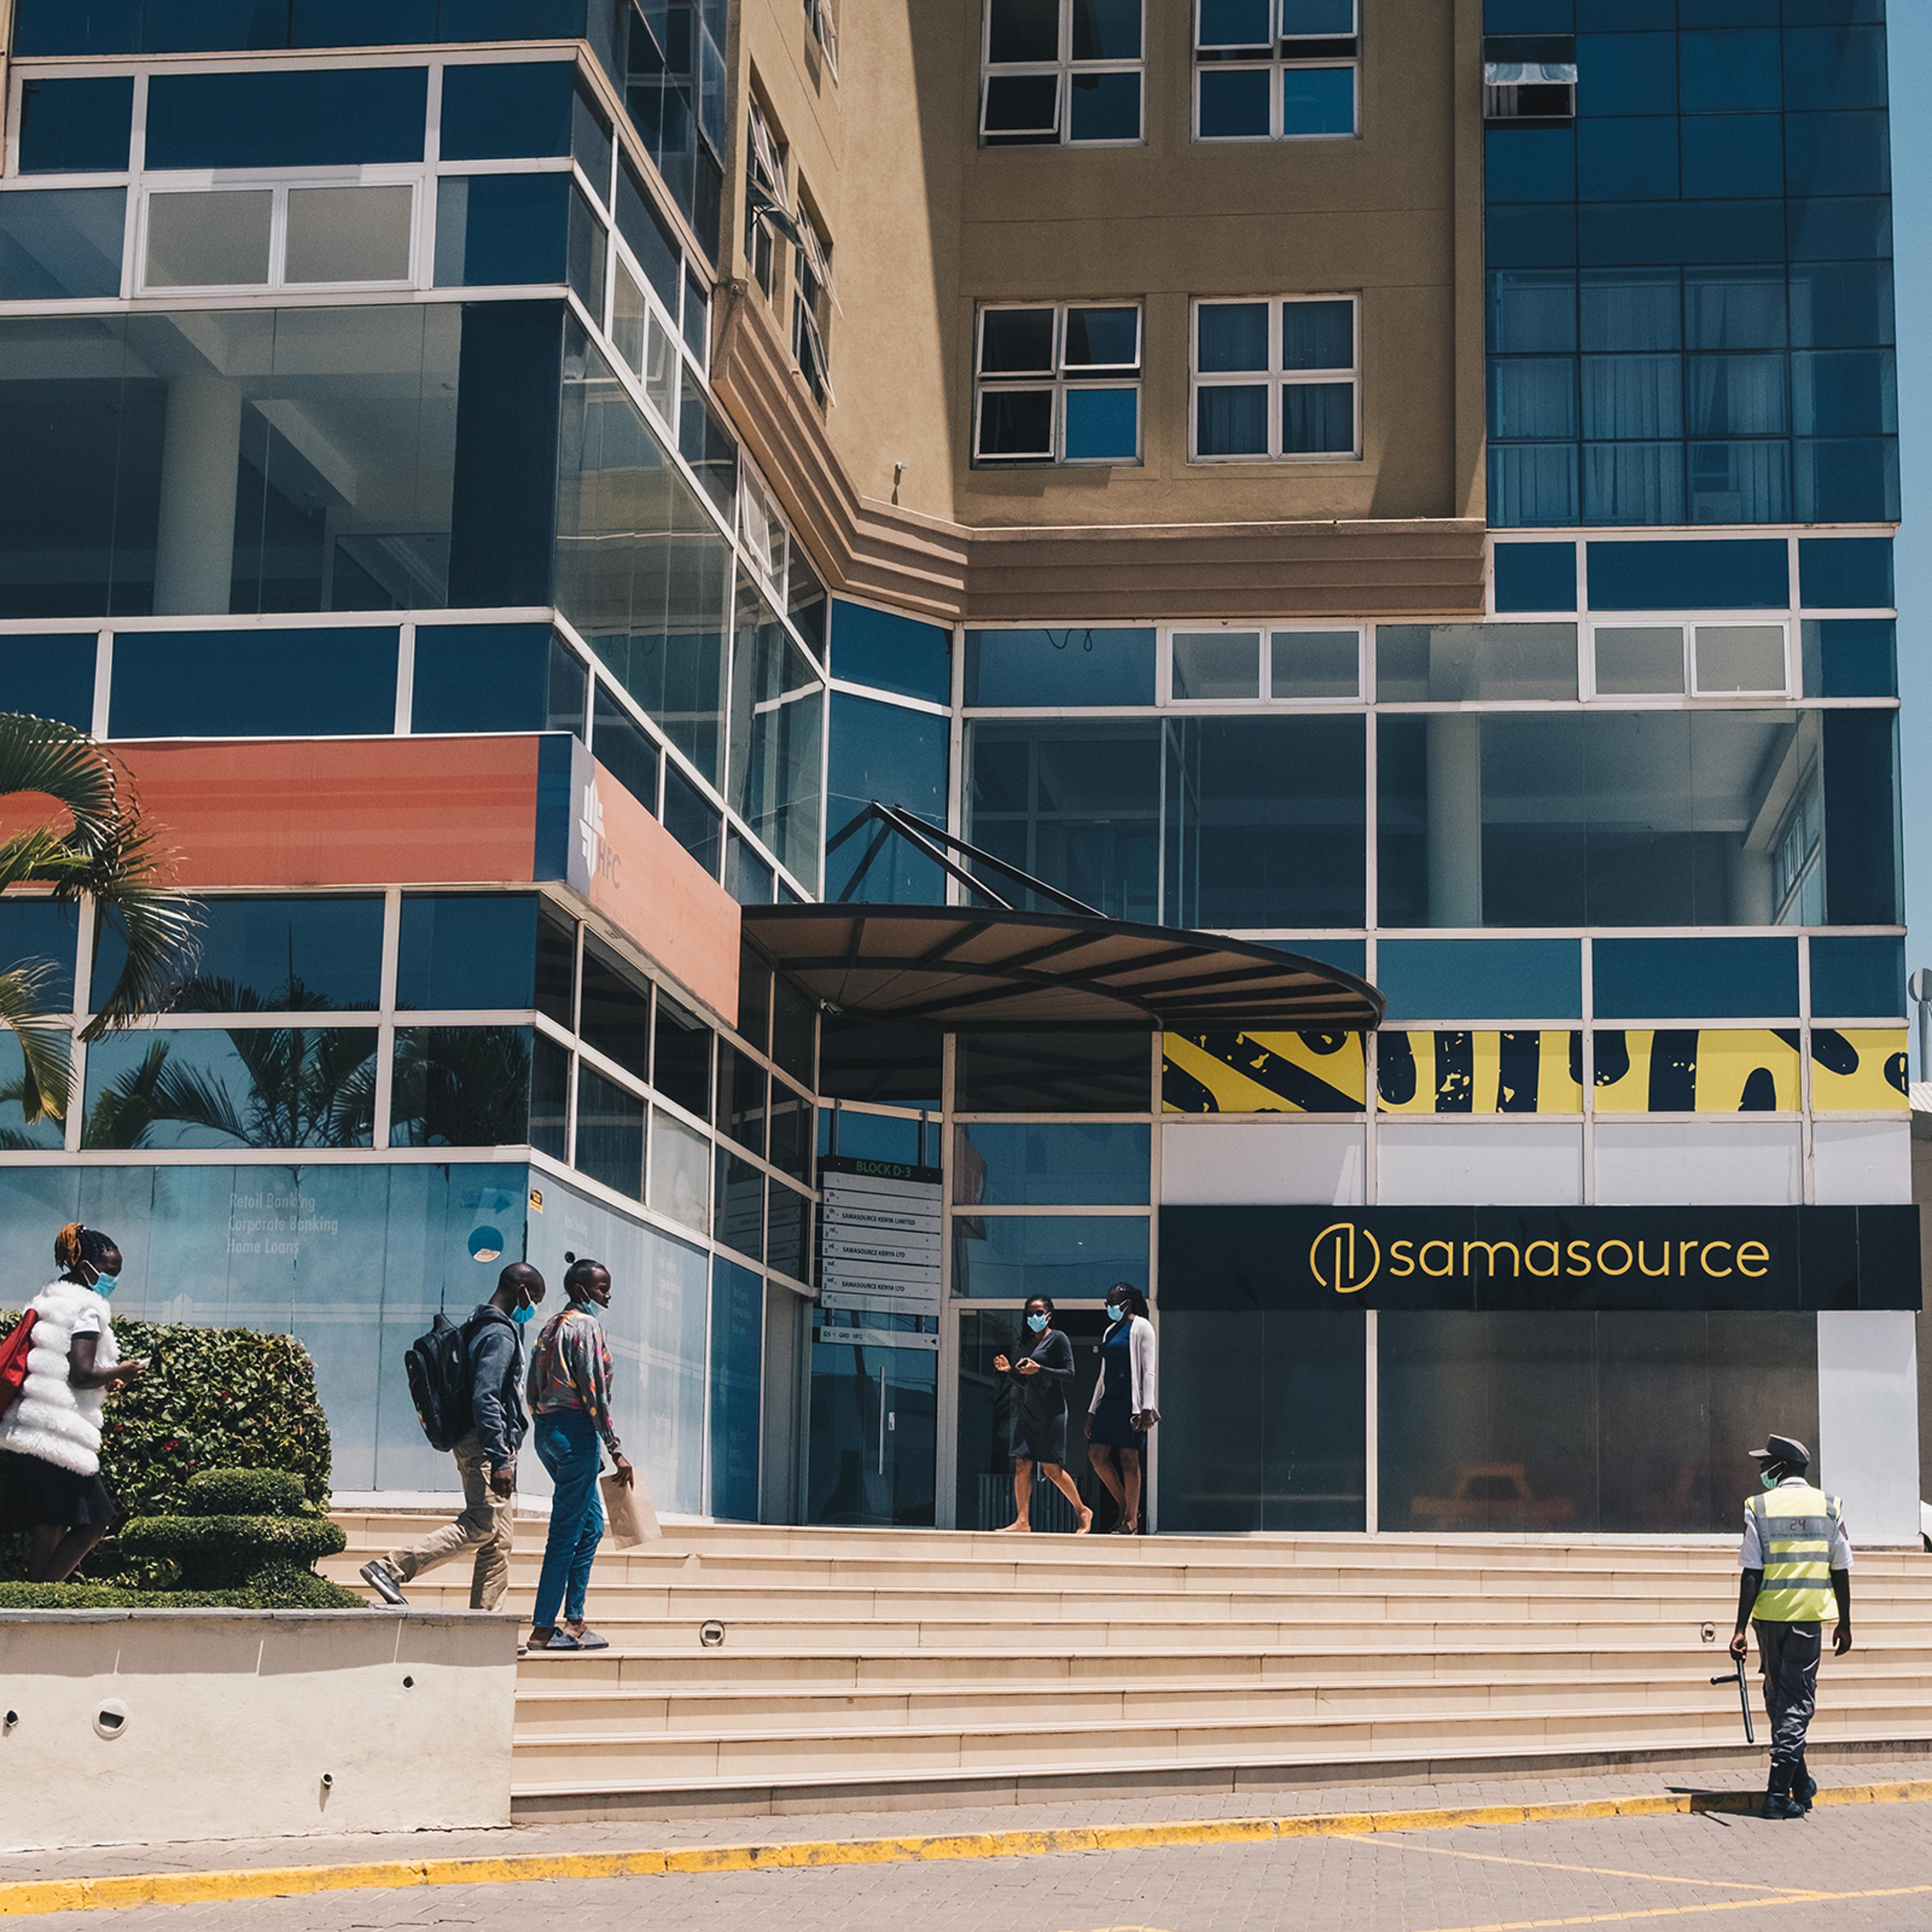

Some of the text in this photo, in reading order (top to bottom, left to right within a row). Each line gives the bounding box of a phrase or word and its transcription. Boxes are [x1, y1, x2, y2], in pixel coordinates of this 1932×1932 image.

[597, 835, 621, 889] HFC
[857, 1161, 891, 1175] BLOCK
[230, 1192, 315, 1212] Retail Banking
[228, 1215, 338, 1235] Corporate Banking
[842, 1213, 876, 1222] SAMASOURCE
[227, 1238, 299, 1255] Home Loans
[842, 1247, 877, 1256] SAMASOURCE
[1390, 1240, 1769, 1276] samasource
[842, 1281, 876, 1289] SAMASOURCE
[1789, 1518, 1806, 1531] 24
